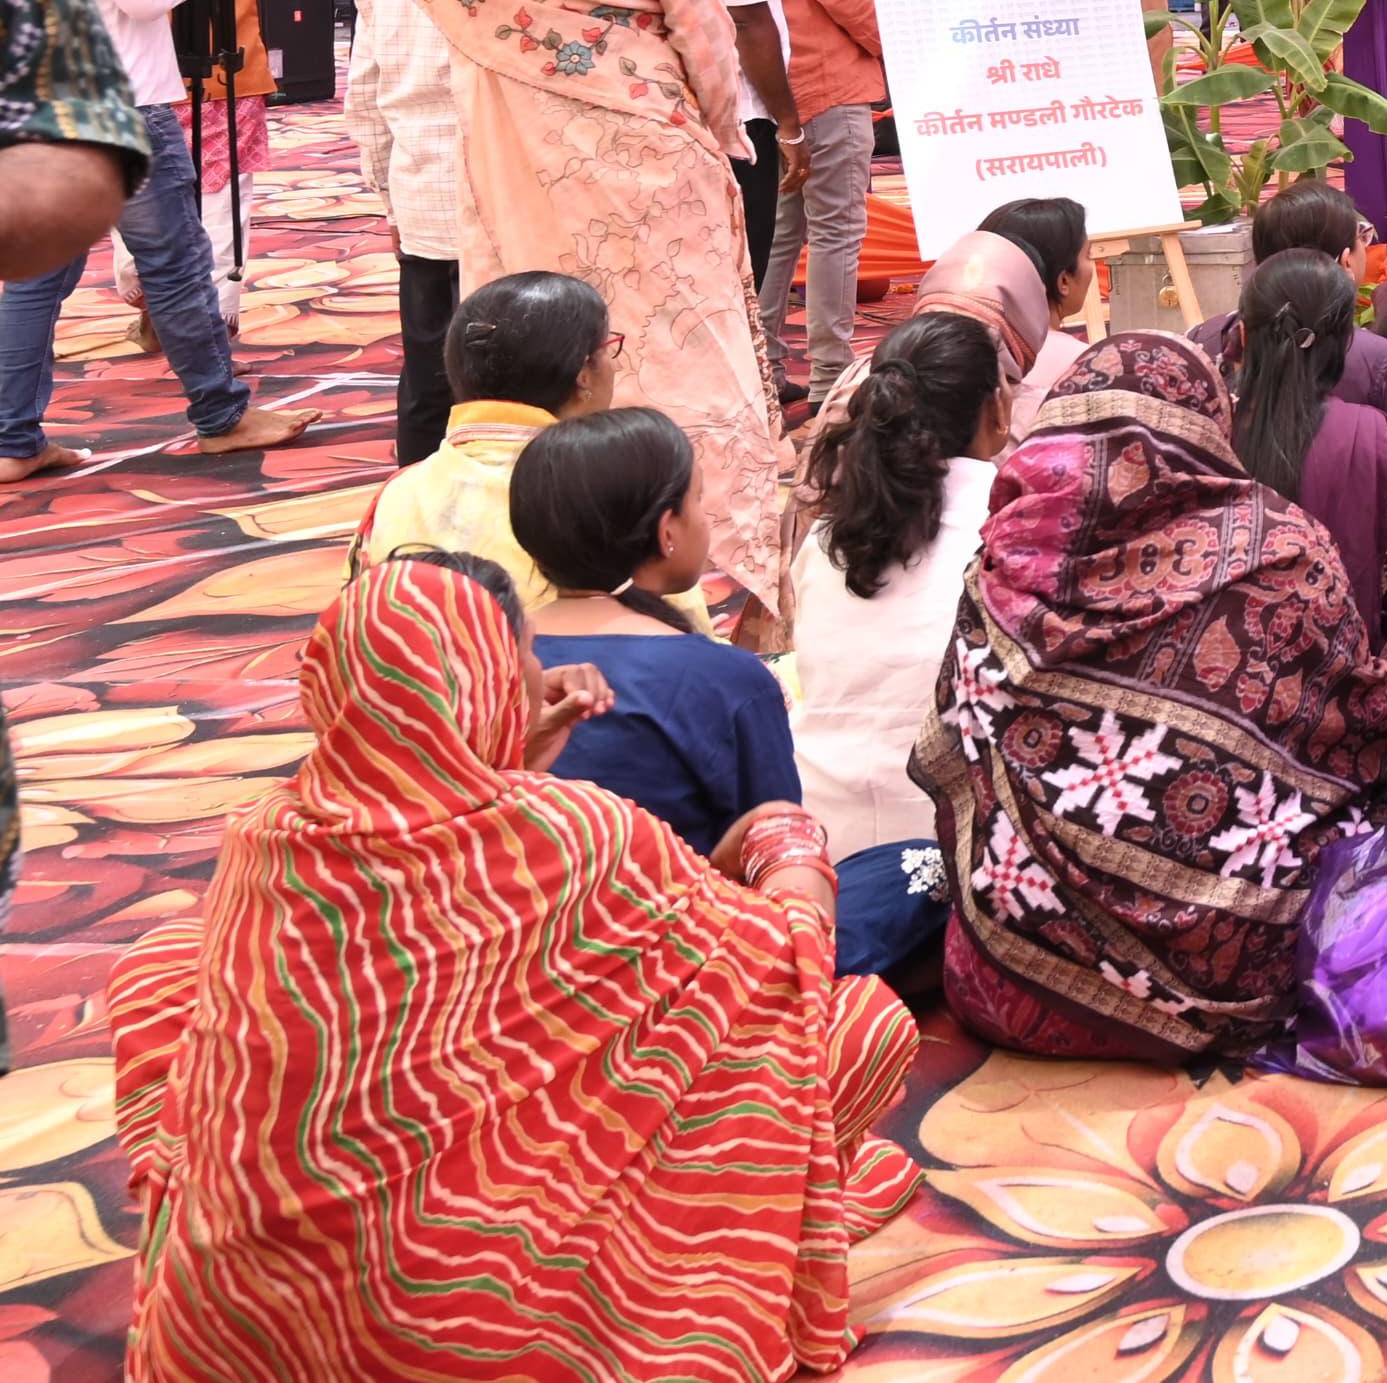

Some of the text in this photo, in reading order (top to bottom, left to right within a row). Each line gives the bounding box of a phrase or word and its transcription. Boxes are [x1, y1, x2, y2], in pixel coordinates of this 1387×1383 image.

[949, 18, 1016, 46] कीर्तन
[1023, 15, 1080, 41] संध्या
[986, 56, 1062, 86] श्री राधे
[914, 95, 1144, 137] कीर्तन मण्डली गौरटेक
[975, 141, 1108, 181] (सरायपाली)
